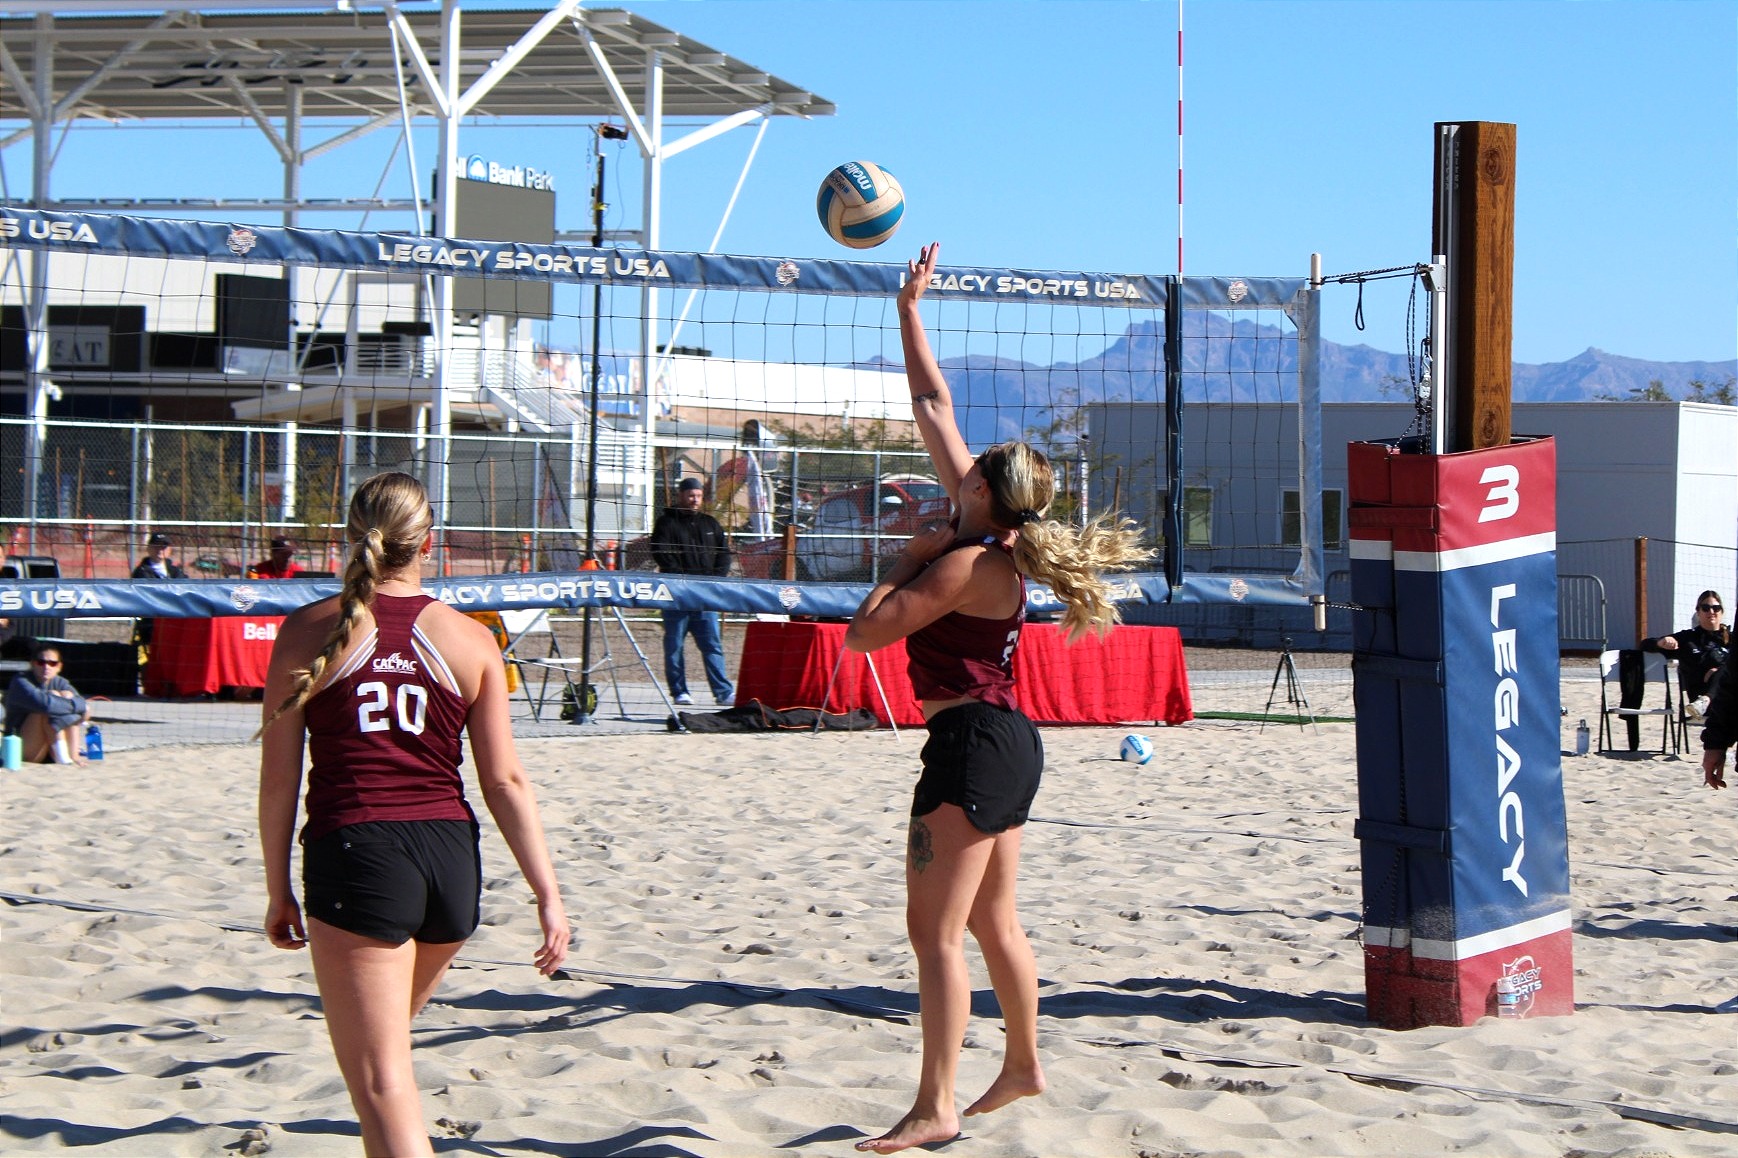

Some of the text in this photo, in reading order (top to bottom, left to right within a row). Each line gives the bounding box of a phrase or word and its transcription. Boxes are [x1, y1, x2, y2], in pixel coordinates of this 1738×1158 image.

[488, 162, 524, 187] Bank
[525, 167, 555, 191] Park
[844, 162, 872, 190] molte
[28, 220, 98, 243] USA
[378, 242, 671, 277] LEGACY SPORTS USA
[900, 271, 1141, 299] LGACY SPORTS USA
[1478, 465, 1519, 523] 3
[32, 590, 103, 609] USA
[501, 581, 611, 601] SPORTS
[618, 583, 674, 601] USA
[373, 658, 418, 671] CAL PAC
[357, 681, 428, 735] 20
[1491, 584, 1528, 898] LEGACY
